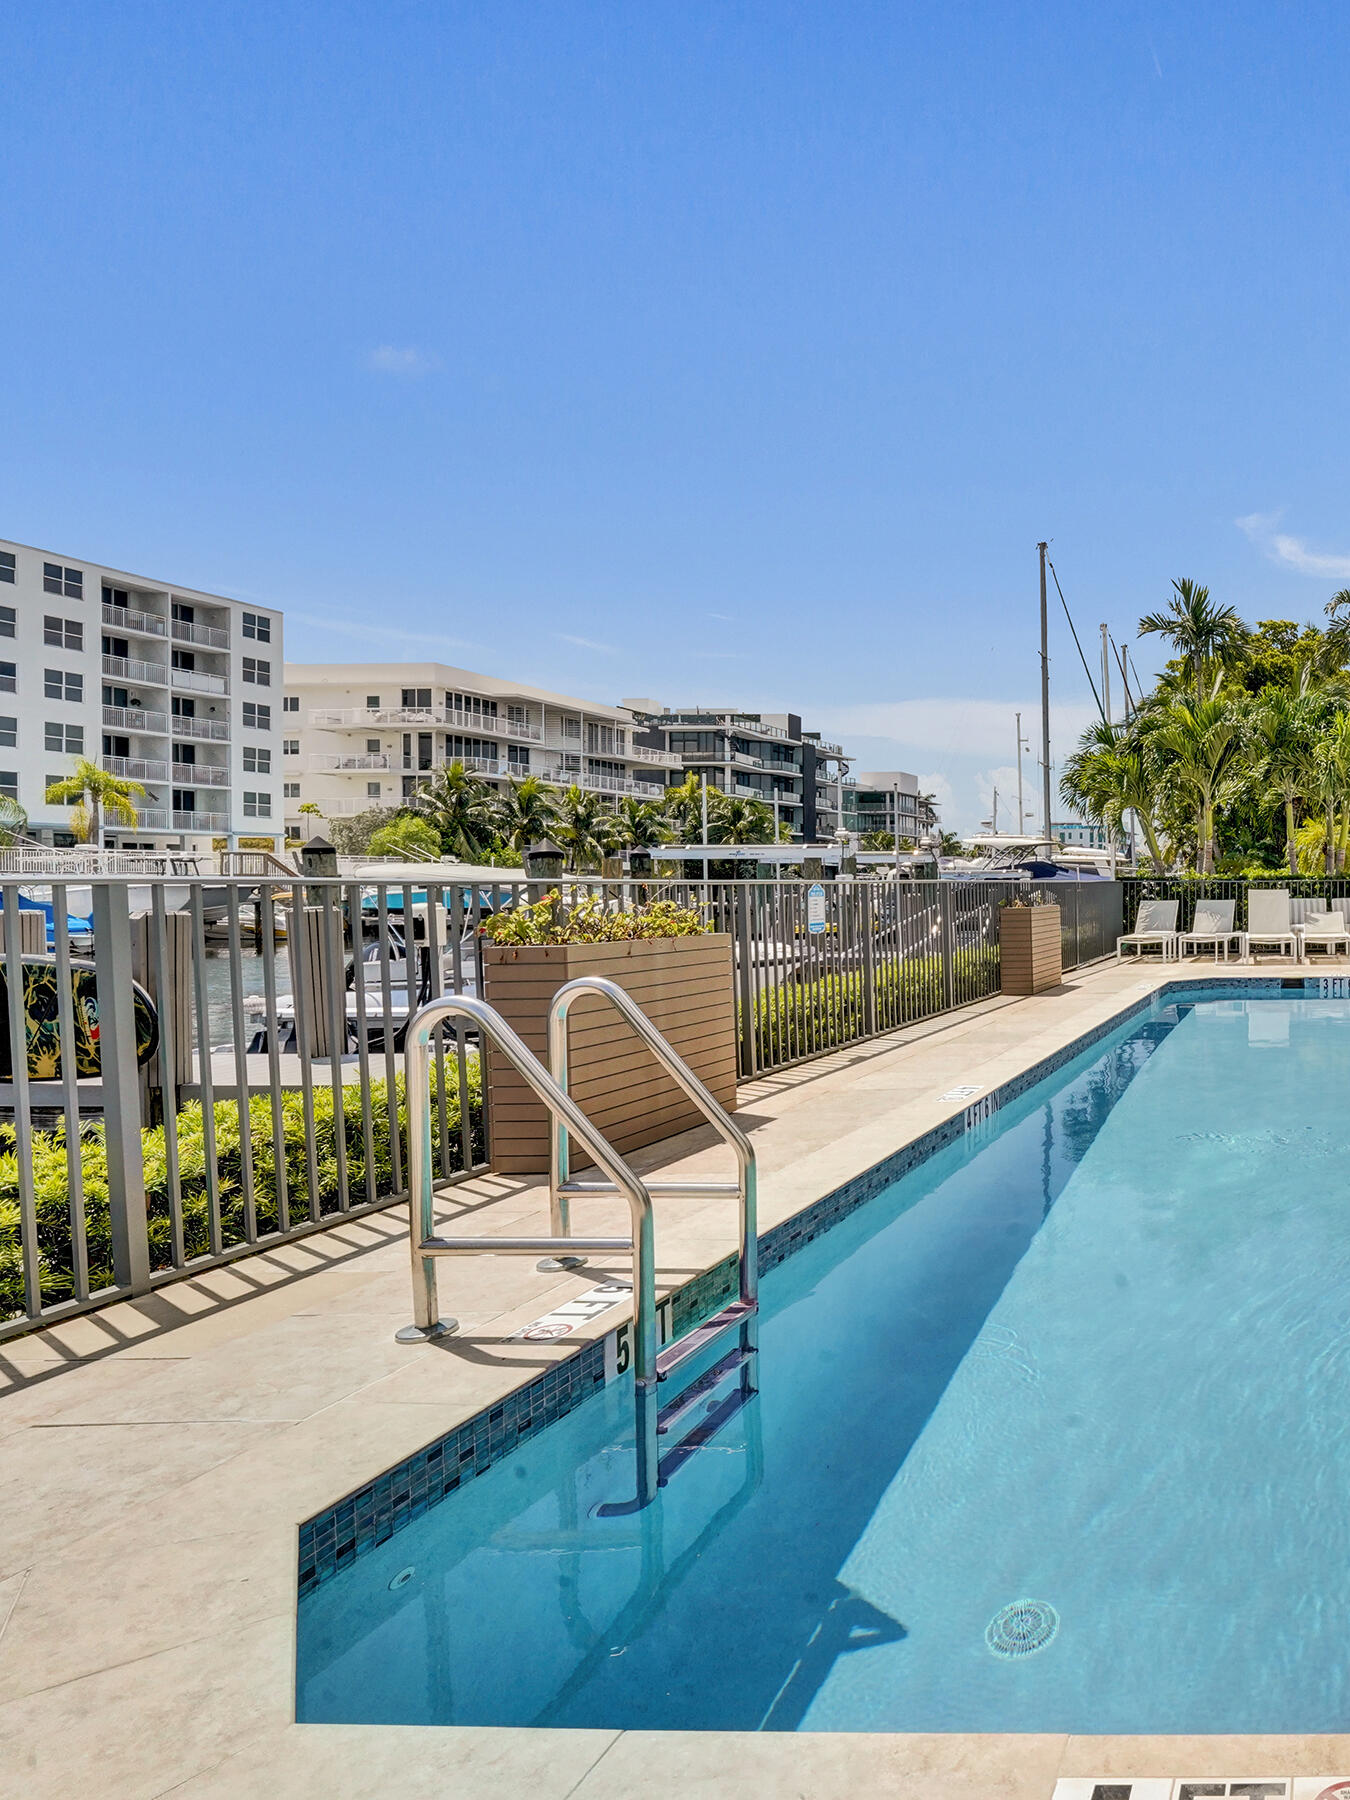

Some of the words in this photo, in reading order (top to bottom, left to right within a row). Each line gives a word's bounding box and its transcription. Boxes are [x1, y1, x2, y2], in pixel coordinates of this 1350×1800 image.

[1323, 978, 1329, 989] 3
[1333, 978, 1343, 989] FT
[593, 1285, 633, 1294] 5
[550, 1300, 620, 1321] FT
[616, 1323, 630, 1375] 5
